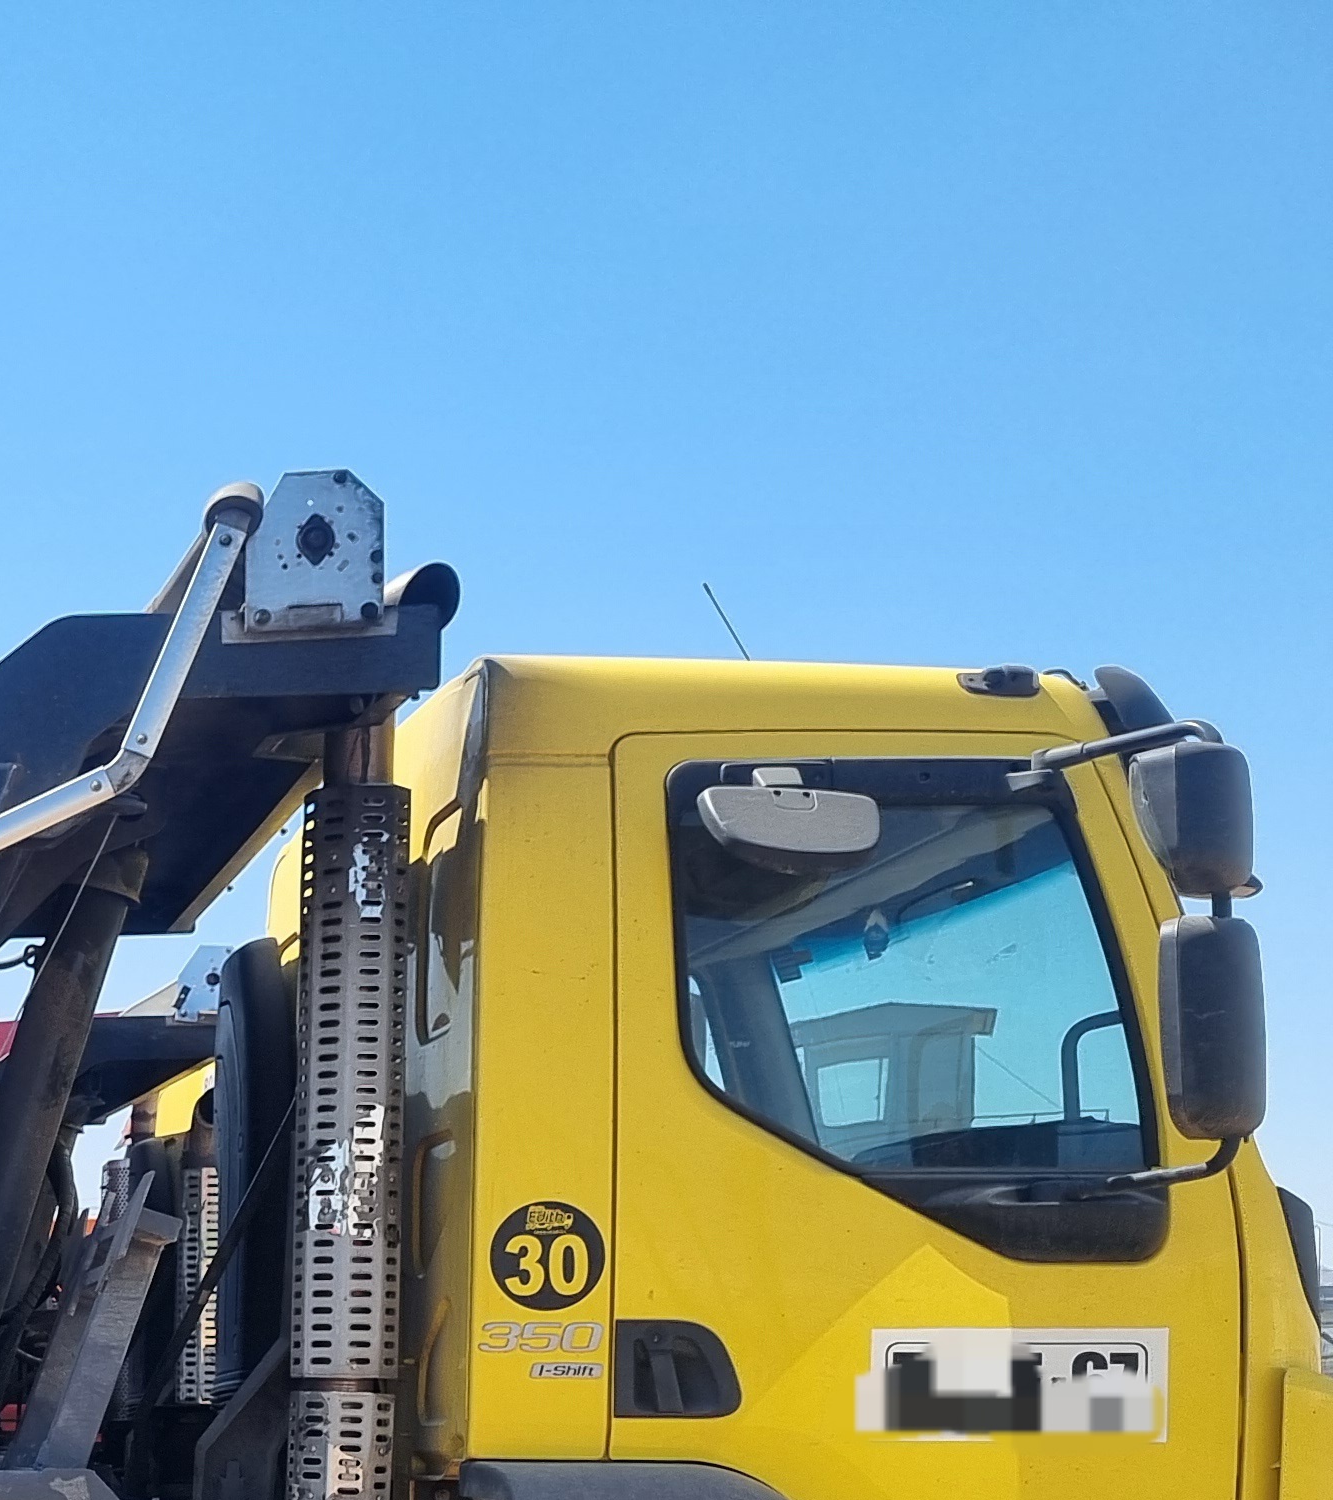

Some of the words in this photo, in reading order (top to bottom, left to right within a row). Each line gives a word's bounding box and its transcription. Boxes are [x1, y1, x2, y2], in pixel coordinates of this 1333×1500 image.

[504, 1233, 589, 1297] 30
[478, 1321, 604, 1353] 350
[538, 1364, 595, 1377] I-Shift
